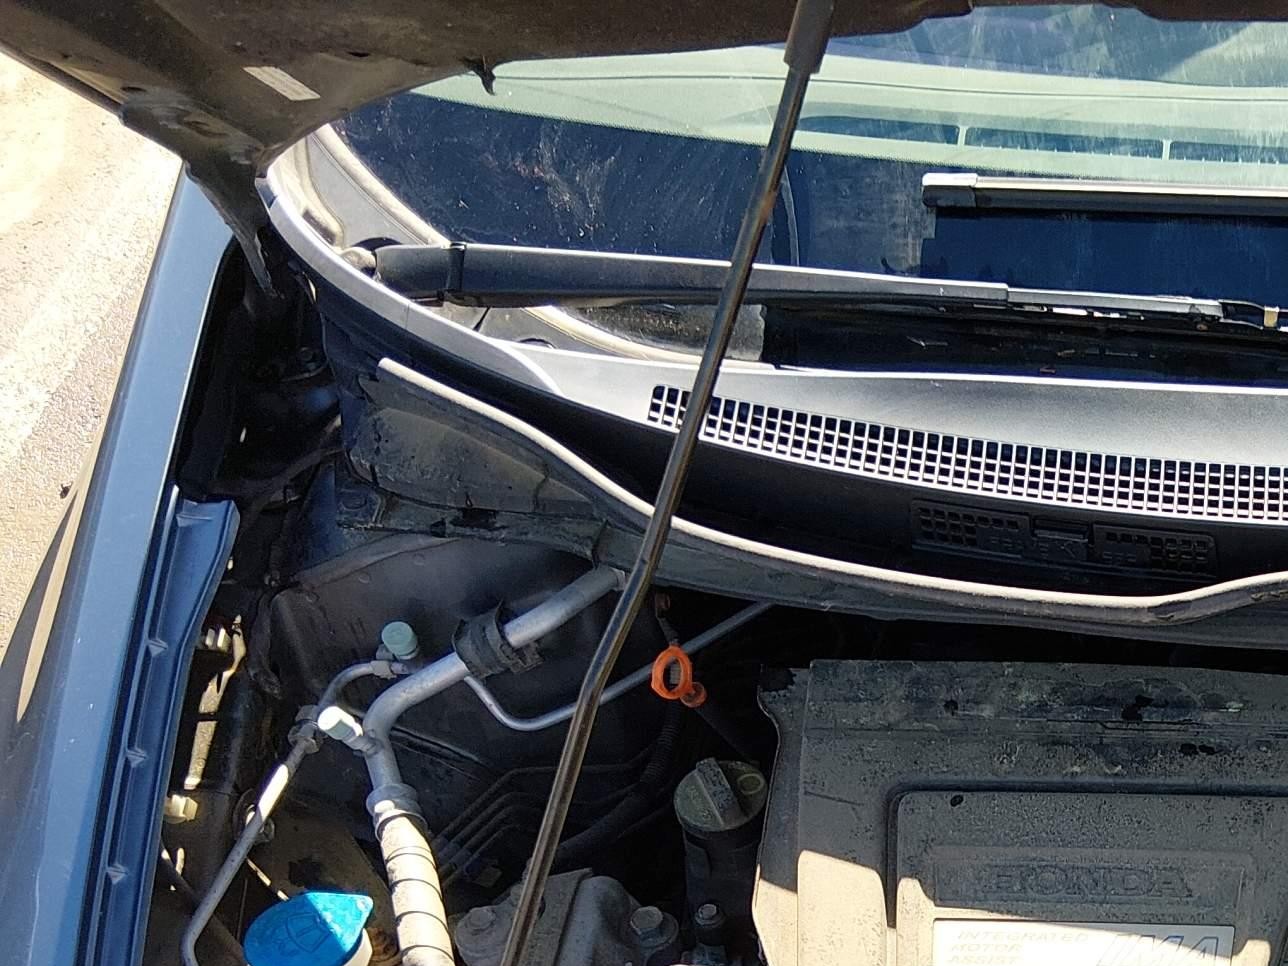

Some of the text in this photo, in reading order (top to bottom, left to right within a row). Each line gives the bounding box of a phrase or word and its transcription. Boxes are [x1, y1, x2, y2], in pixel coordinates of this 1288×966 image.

[982, 863, 1195, 898] HONDA
[955, 930, 1090, 943] INTEGRATED
[949, 943, 1022, 953] MOTOR
[947, 955, 1021, 965] ASSIST
